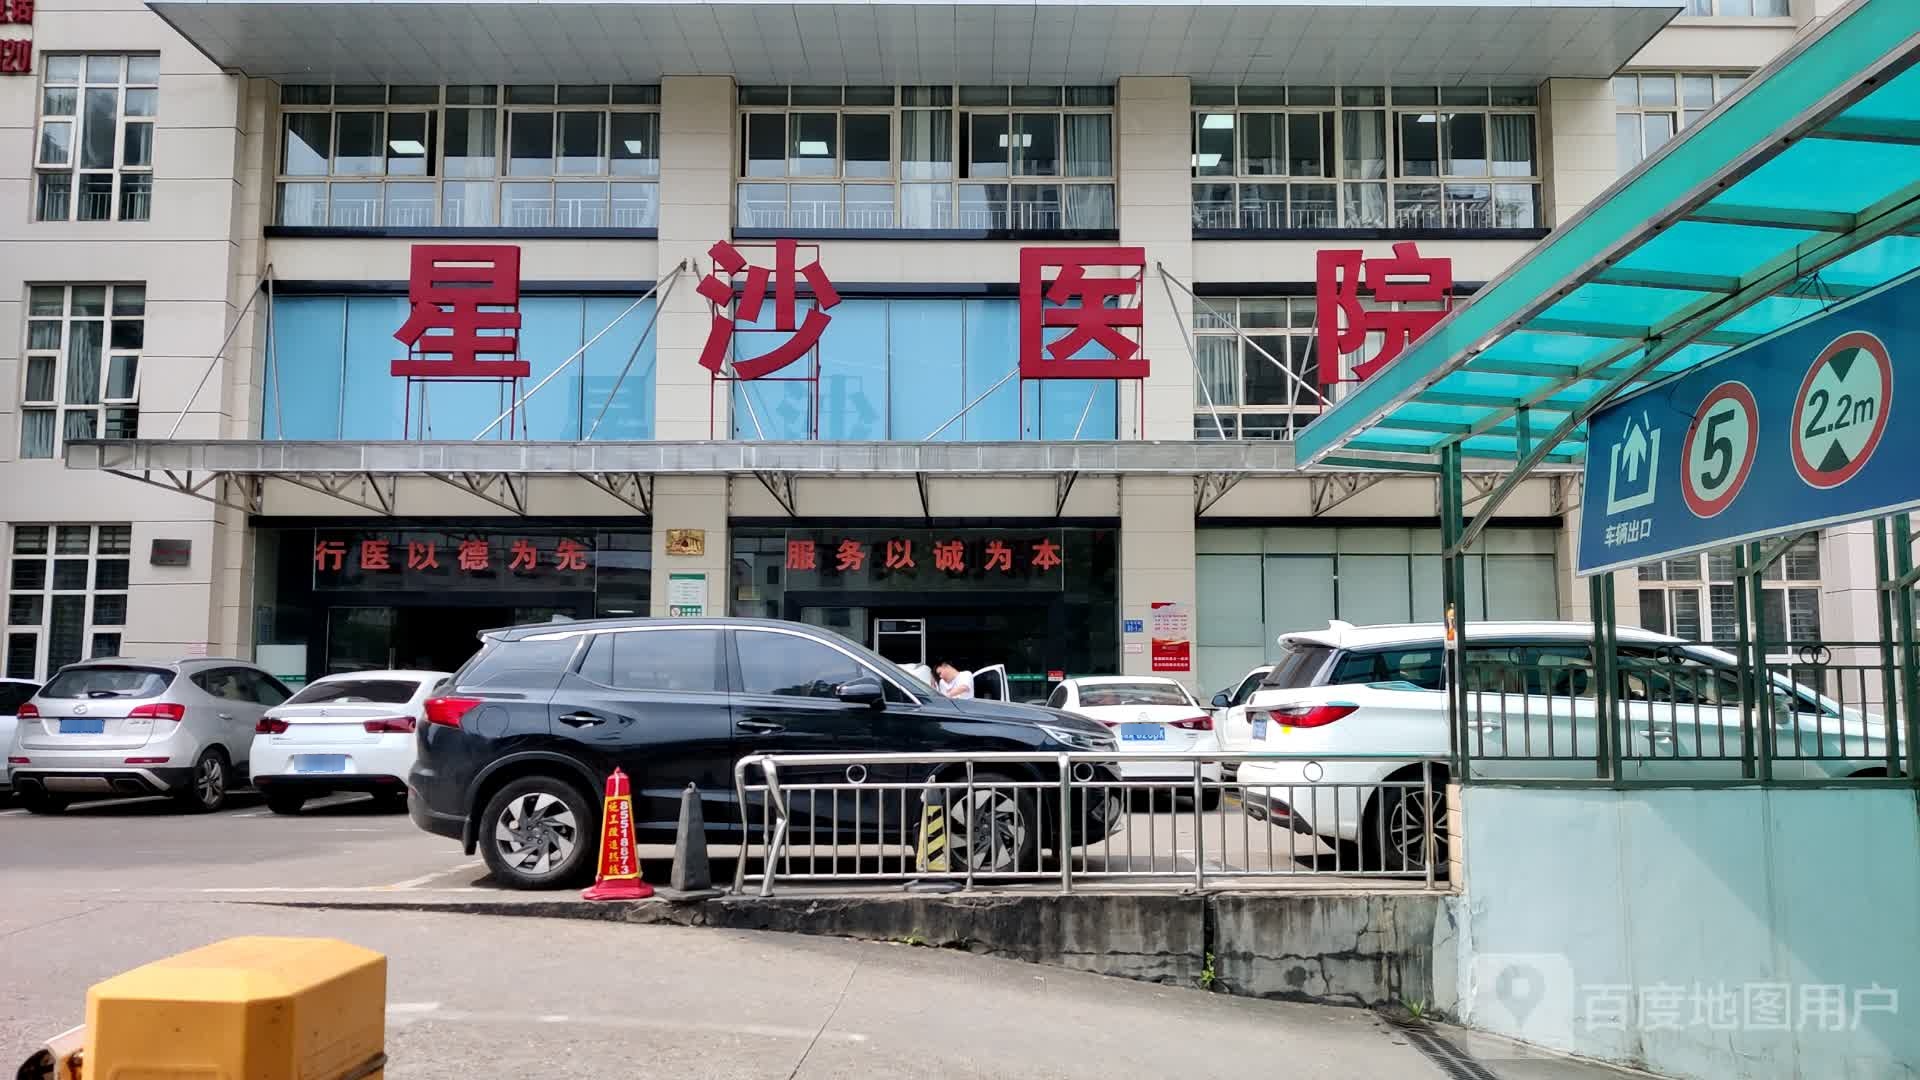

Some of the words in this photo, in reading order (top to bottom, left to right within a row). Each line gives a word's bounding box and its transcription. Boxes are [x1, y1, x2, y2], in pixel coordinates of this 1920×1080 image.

[391, 239, 1452, 385] 星沙医院
[1805, 389, 1874, 439] 2.2m
[1701, 409, 1735, 490] 5
[315, 539, 587, 571] 行医以德为先
[786, 539, 1062, 571] 服务以诚为本
[1604, 518, 1652, 547] 车辆出口
[620, 800, 629, 875] 85518873
